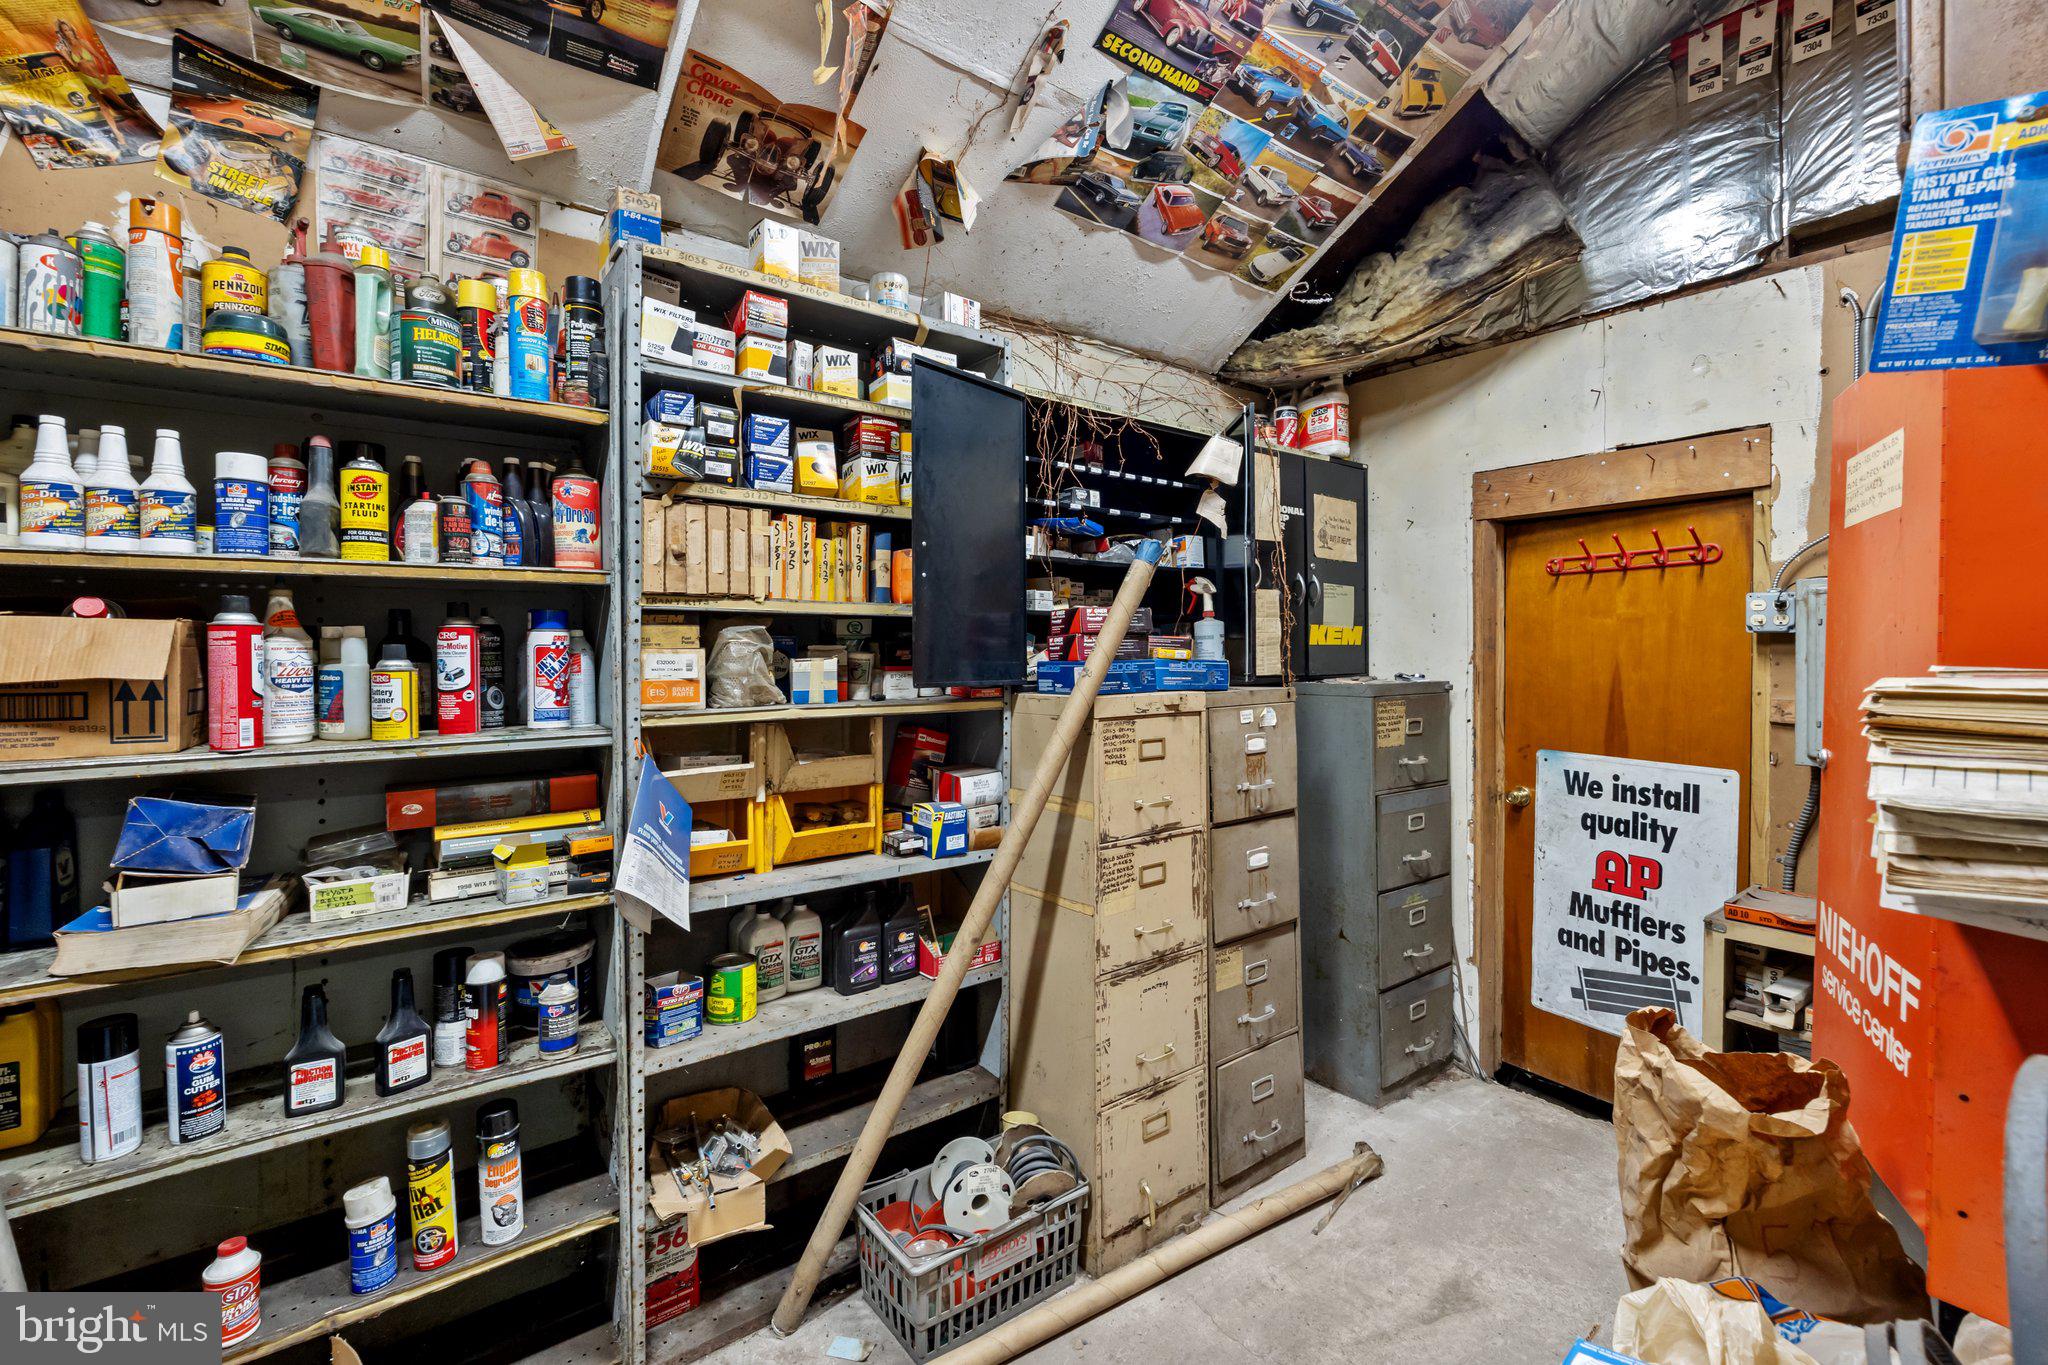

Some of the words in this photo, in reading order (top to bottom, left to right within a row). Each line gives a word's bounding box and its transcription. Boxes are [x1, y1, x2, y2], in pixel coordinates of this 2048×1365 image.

[1866, 10, 1889, 27] 7330
[1802, 40, 1823, 54] 7304
[1102, 33, 1163, 83] SECOND
[1161, 64, 1201, 96] HAND
[1745, 63, 1765, 77] 7292
[690, 63, 741, 94] Cover
[686, 80, 735, 109] Clone
[1696, 81, 1715, 94] 7260
[207, 160, 269, 190] STREET
[1912, 167, 1980, 192] INSTANT
[1981, 161, 2017, 183] GAS
[207, 174, 274, 207] MUSCLE
[1910, 184, 1952, 204] TANK
[1953, 175, 2016, 196] REPAIR
[1907, 198, 1965, 214] REPARADOR
[1971, 201, 1999, 213] PARA
[624, 210, 641, 221] V-64
[1904, 217, 1948, 231] TANQUES
[1947, 215, 1961, 227] DE
[801, 240, 837, 259] WIX
[212, 279, 264, 297] PENNZOIL
[653, 276, 679, 289] FILTERS
[419, 289, 443, 300] Ford
[750, 293, 785, 309] Motorcraft
[653, 306, 667, 316] WIX
[668, 310, 694, 324] FILTERS
[696, 342, 708, 350] OIL
[697, 332, 731, 348] PROTEC
[765, 343, 784, 351] FILTERS
[825, 354, 851, 367] WIX
[1893, 360, 1906, 368] WT
[1914, 359, 1926, 367] OZ
[1312, 406, 1329, 418] CRC
[798, 430, 819, 440] WIX
[866, 462, 888, 476] WIX
[347, 484, 383, 493] INSTANT
[226, 497, 245, 505] BRAKE
[344, 501, 386, 513] STARTING
[352, 509, 379, 519] FLUID
[438, 631, 458, 640] CRC
[1309, 624, 1363, 646] KEM
[277, 667, 314, 677] LUCAS
[372, 674, 390, 684] CRC
[275, 677, 298, 685] HEAVY
[649, 688, 666, 697] EIS
[1563, 769, 1604, 799] We
[1612, 774, 1700, 814] install
[1580, 810, 1678, 854] quality
[1591, 850, 1663, 901] AP
[1569, 890, 1686, 944] Mufflers
[1728, 908, 1739, 918] AD
[1740, 910, 1750, 919] 10
[793, 952, 819, 962] Diesel
[794, 944, 818, 956] GTX
[1557, 927, 1606, 958] and
[1615, 935, 1700, 986] Pipes.
[759, 960, 784, 972] Diesel
[760, 953, 782, 965] GTX
[1819, 900, 1922, 1023] NIEHOFF
[1822, 965, 1862, 1025] service
[1861, 1009, 1911, 1078] center
[391, 1041, 424, 1058] FRICTION
[391, 1046, 425, 1065] MODIFIER
[295, 1066, 333, 1079] FRICTION
[295, 1072, 333, 1086] MODIFIER
[184, 1079, 221, 1096] CUTTER
[191, 1075, 214, 1088] GUM
[487, 1156, 519, 1178] Engine
[410, 1185, 427, 1203] fix
[412, 1197, 444, 1221] flat
[225, 1285, 250, 1304] STP
